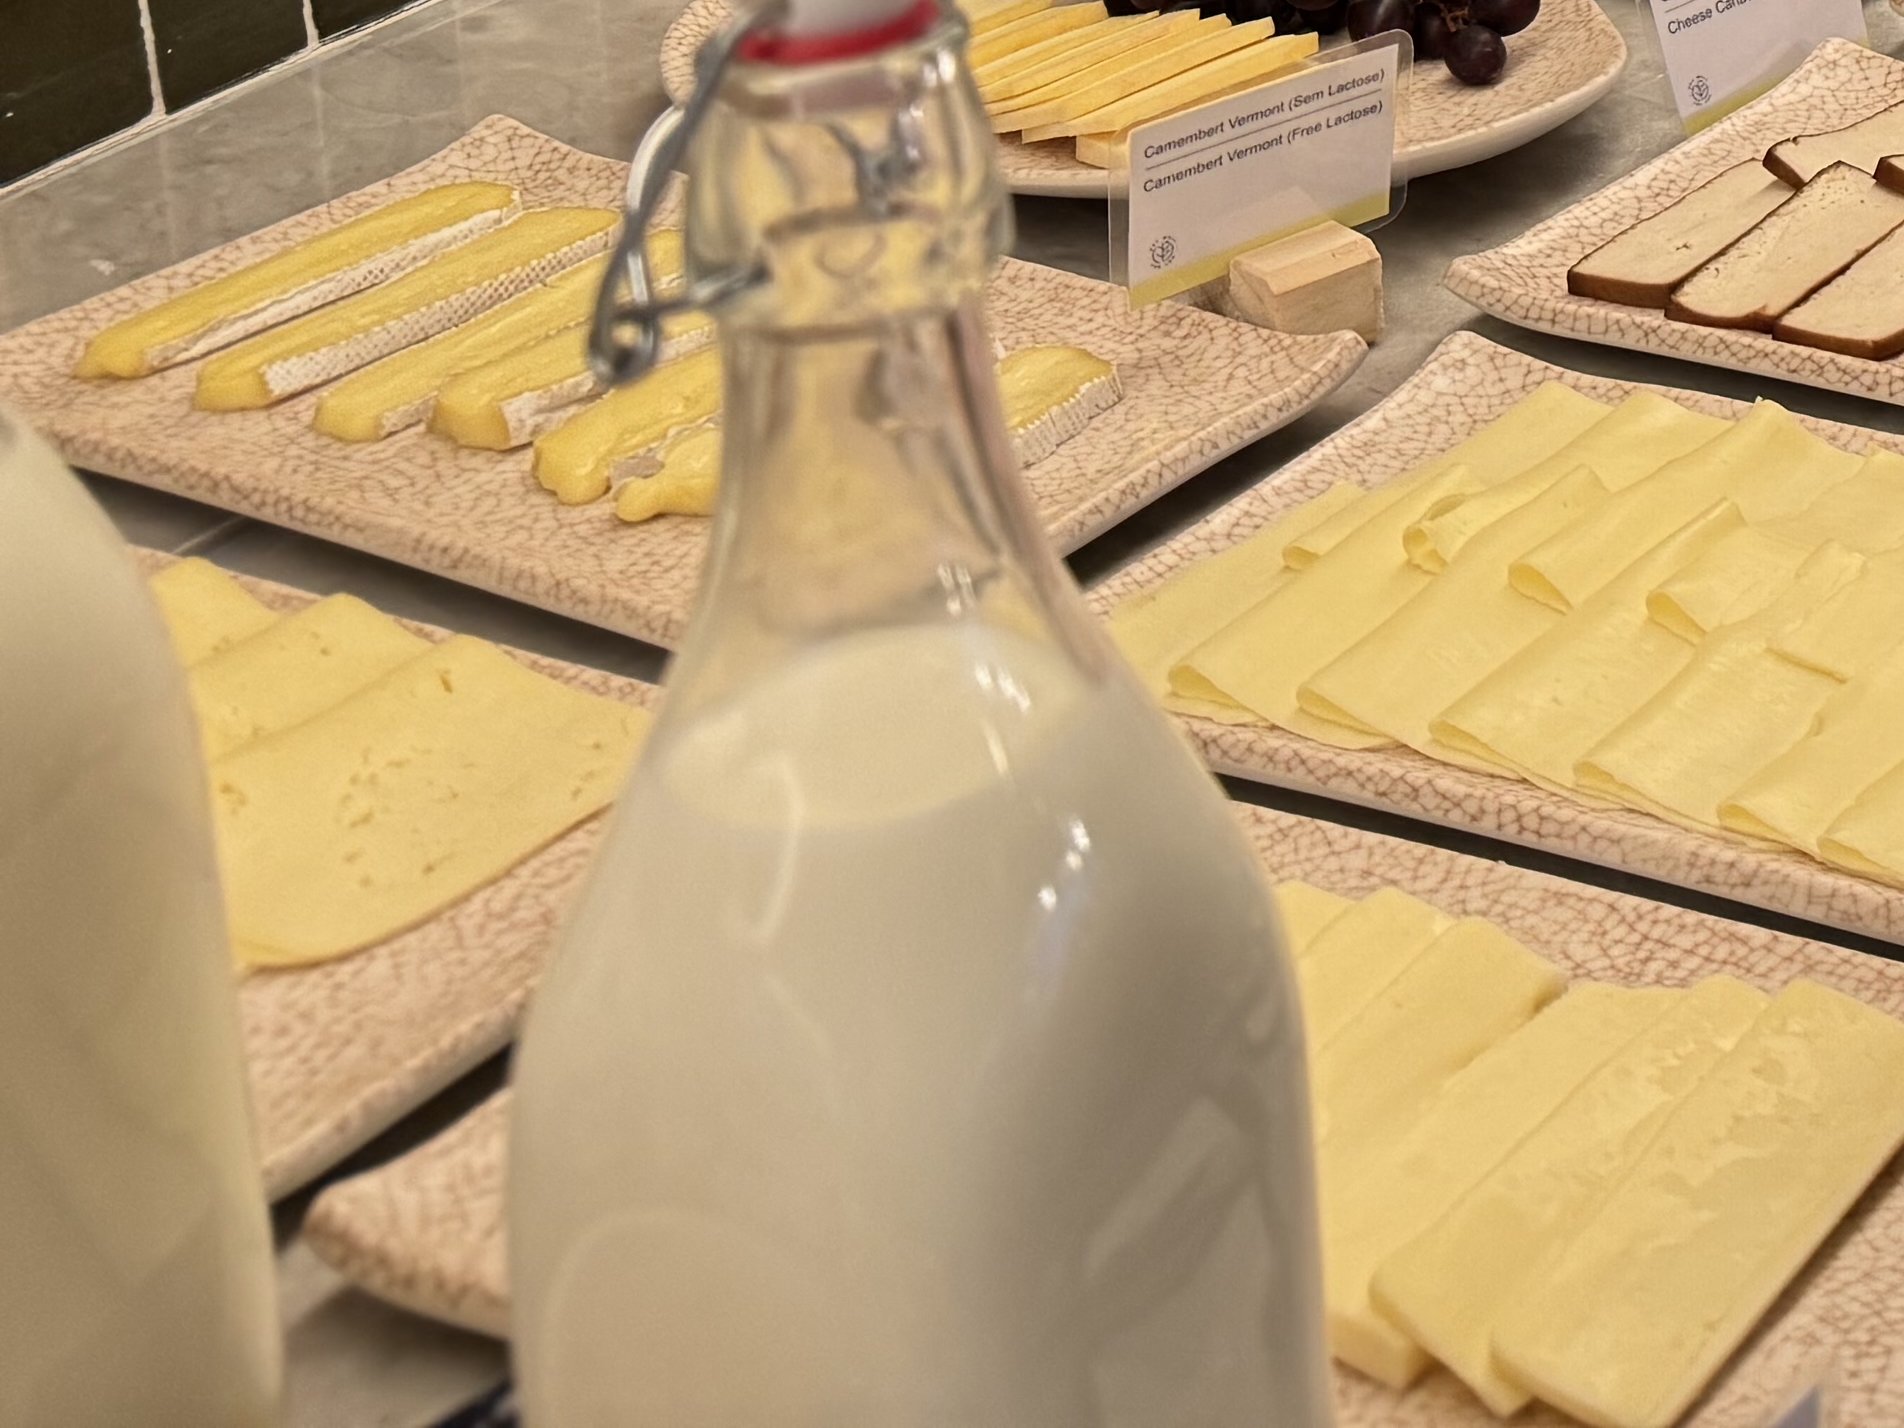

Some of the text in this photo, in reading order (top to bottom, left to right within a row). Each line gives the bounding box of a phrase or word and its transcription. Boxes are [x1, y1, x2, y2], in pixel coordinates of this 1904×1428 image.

[1667, 5, 1714, 35] Cheese
[1142, 99, 1384, 193] Camembert Vermont (Free Lactose)
[1143, 67, 1386, 160] Camembert Vermont (Sem Lactose)
